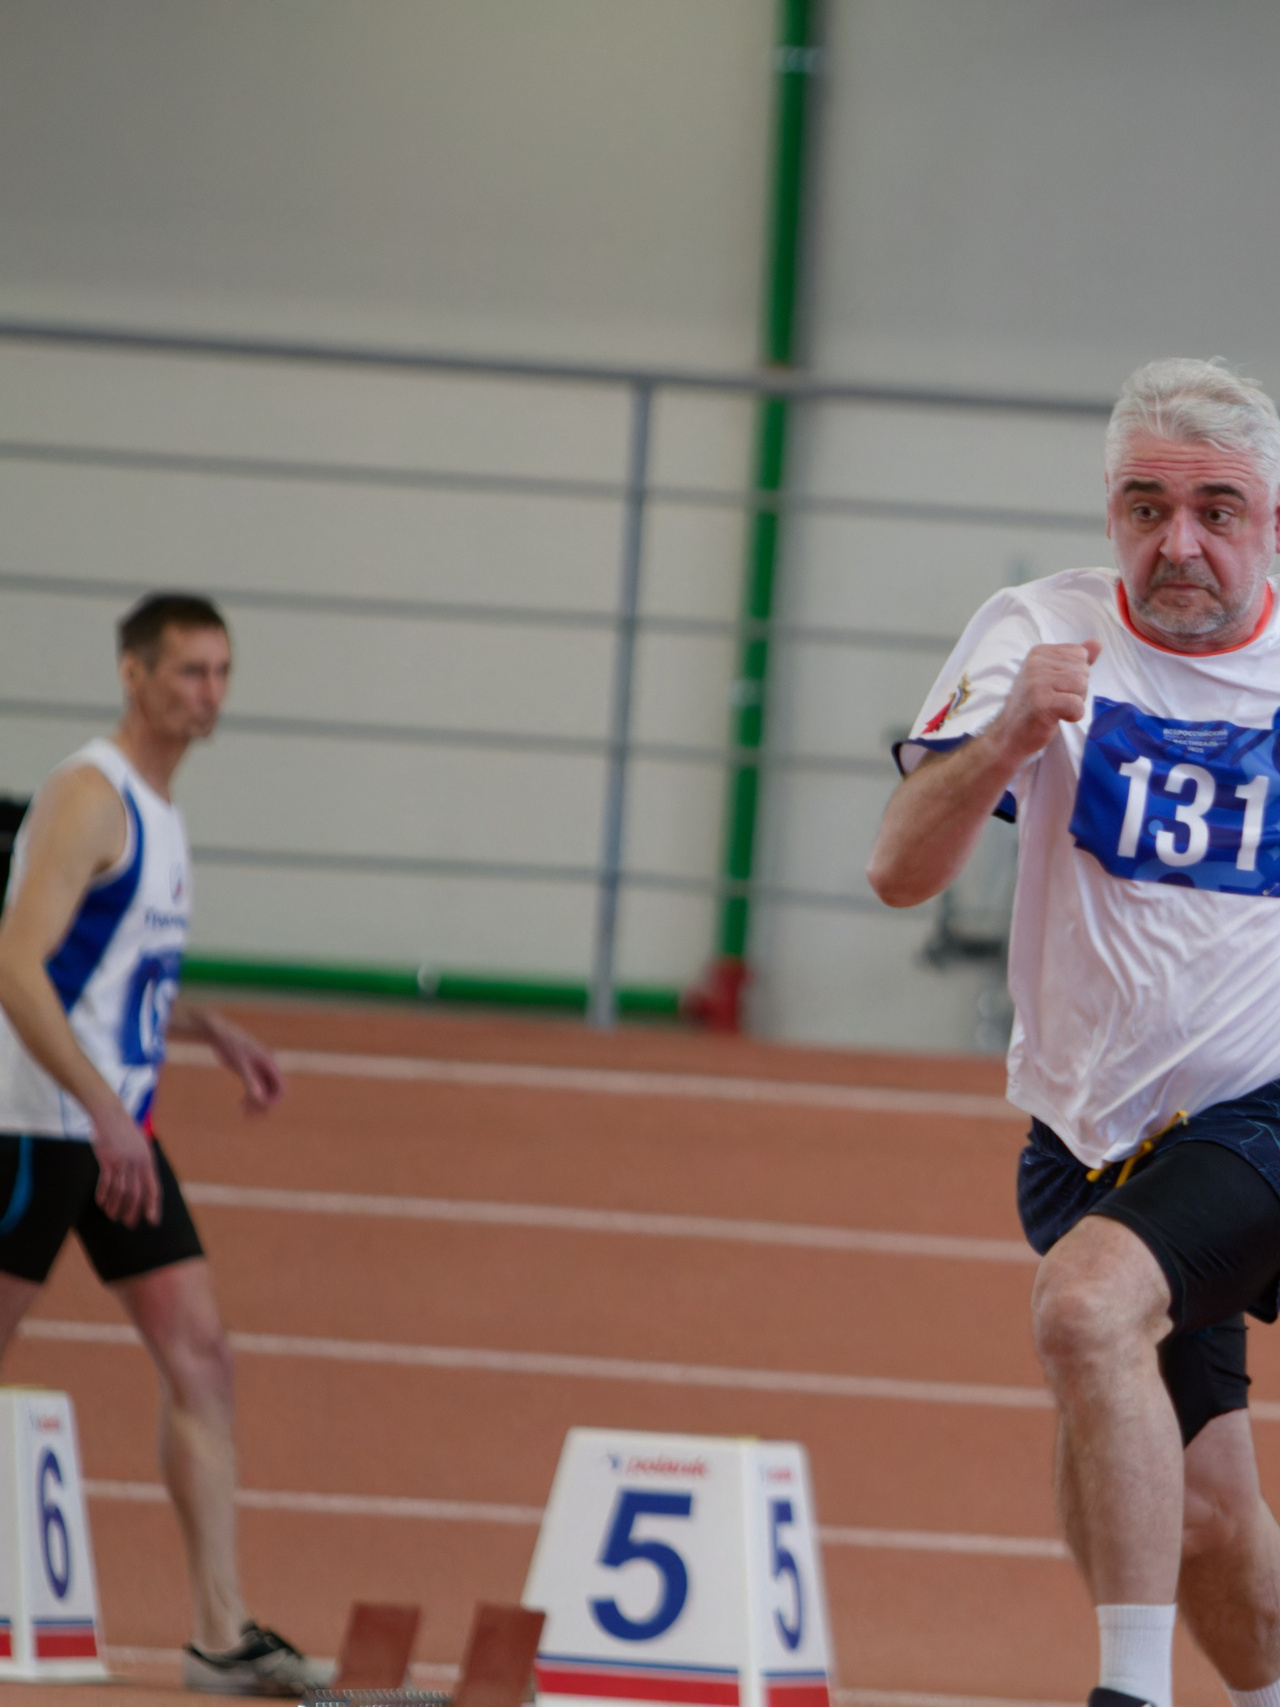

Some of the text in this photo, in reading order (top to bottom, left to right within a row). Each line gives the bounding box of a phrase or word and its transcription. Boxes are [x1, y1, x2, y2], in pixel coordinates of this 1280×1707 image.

[1117, 755, 1269, 872] 131
[36, 1447, 70, 1600] 6
[587, 1488, 692, 1642] 5
[768, 1498, 803, 1652] 5
